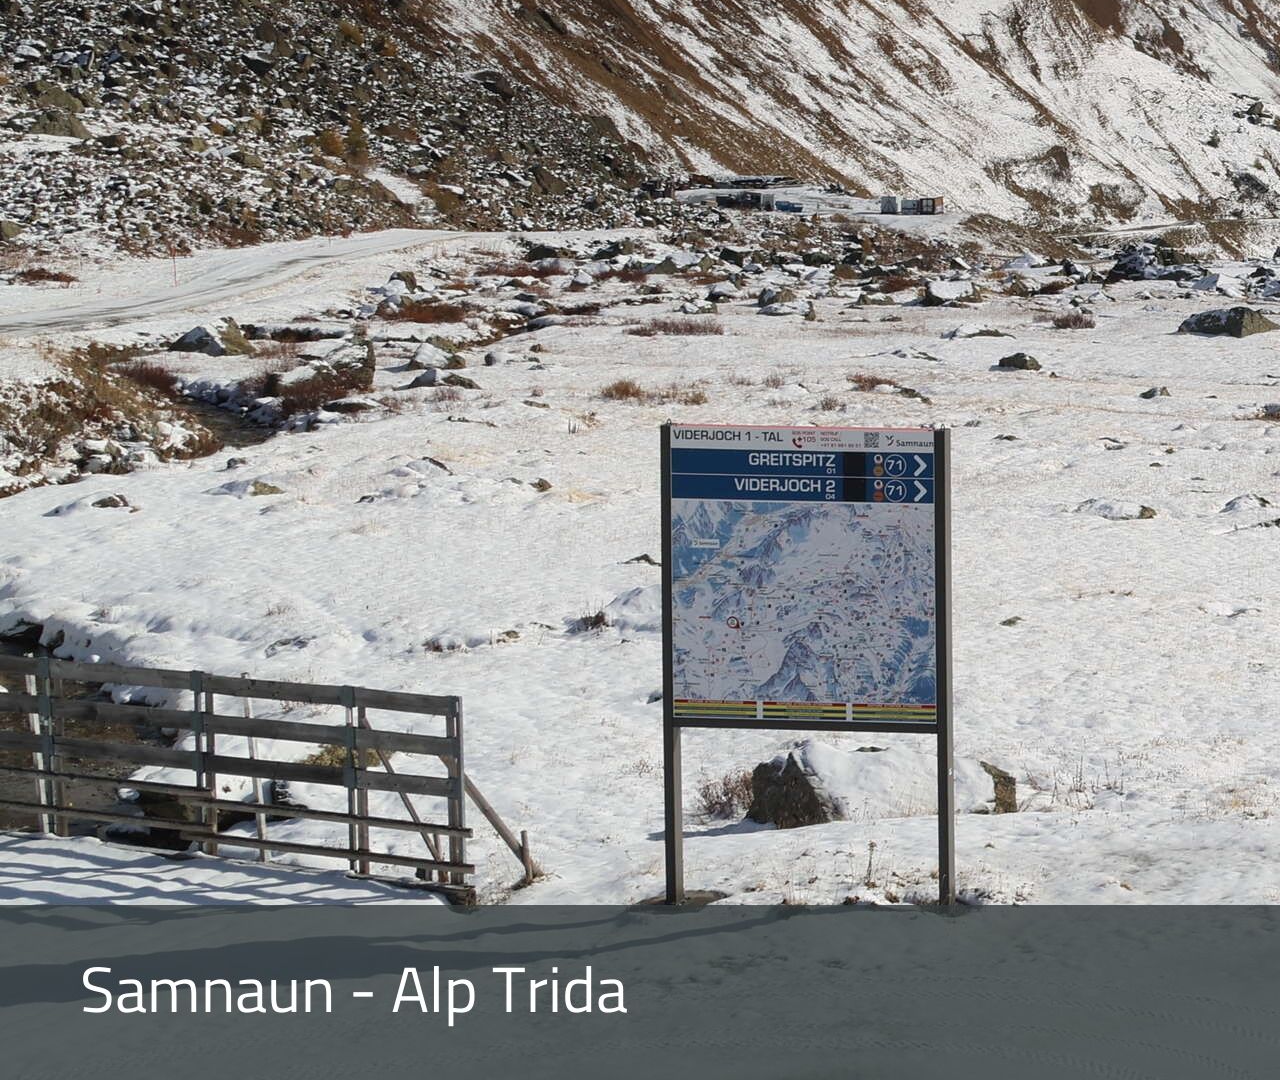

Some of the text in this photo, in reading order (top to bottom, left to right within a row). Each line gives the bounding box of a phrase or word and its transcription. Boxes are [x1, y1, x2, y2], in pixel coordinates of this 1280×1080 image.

[673, 429, 741, 441] VIDERJOCH
[745, 431, 751, 441] 1
[762, 431, 784, 442] TAL
[896, 439, 934, 448] Samnaun
[748, 452, 836, 467] GREITSPITZ
[887, 460, 903, 471] 71
[734, 478, 836, 493] VIDERJOCH 2
[887, 485, 903, 496] 71
